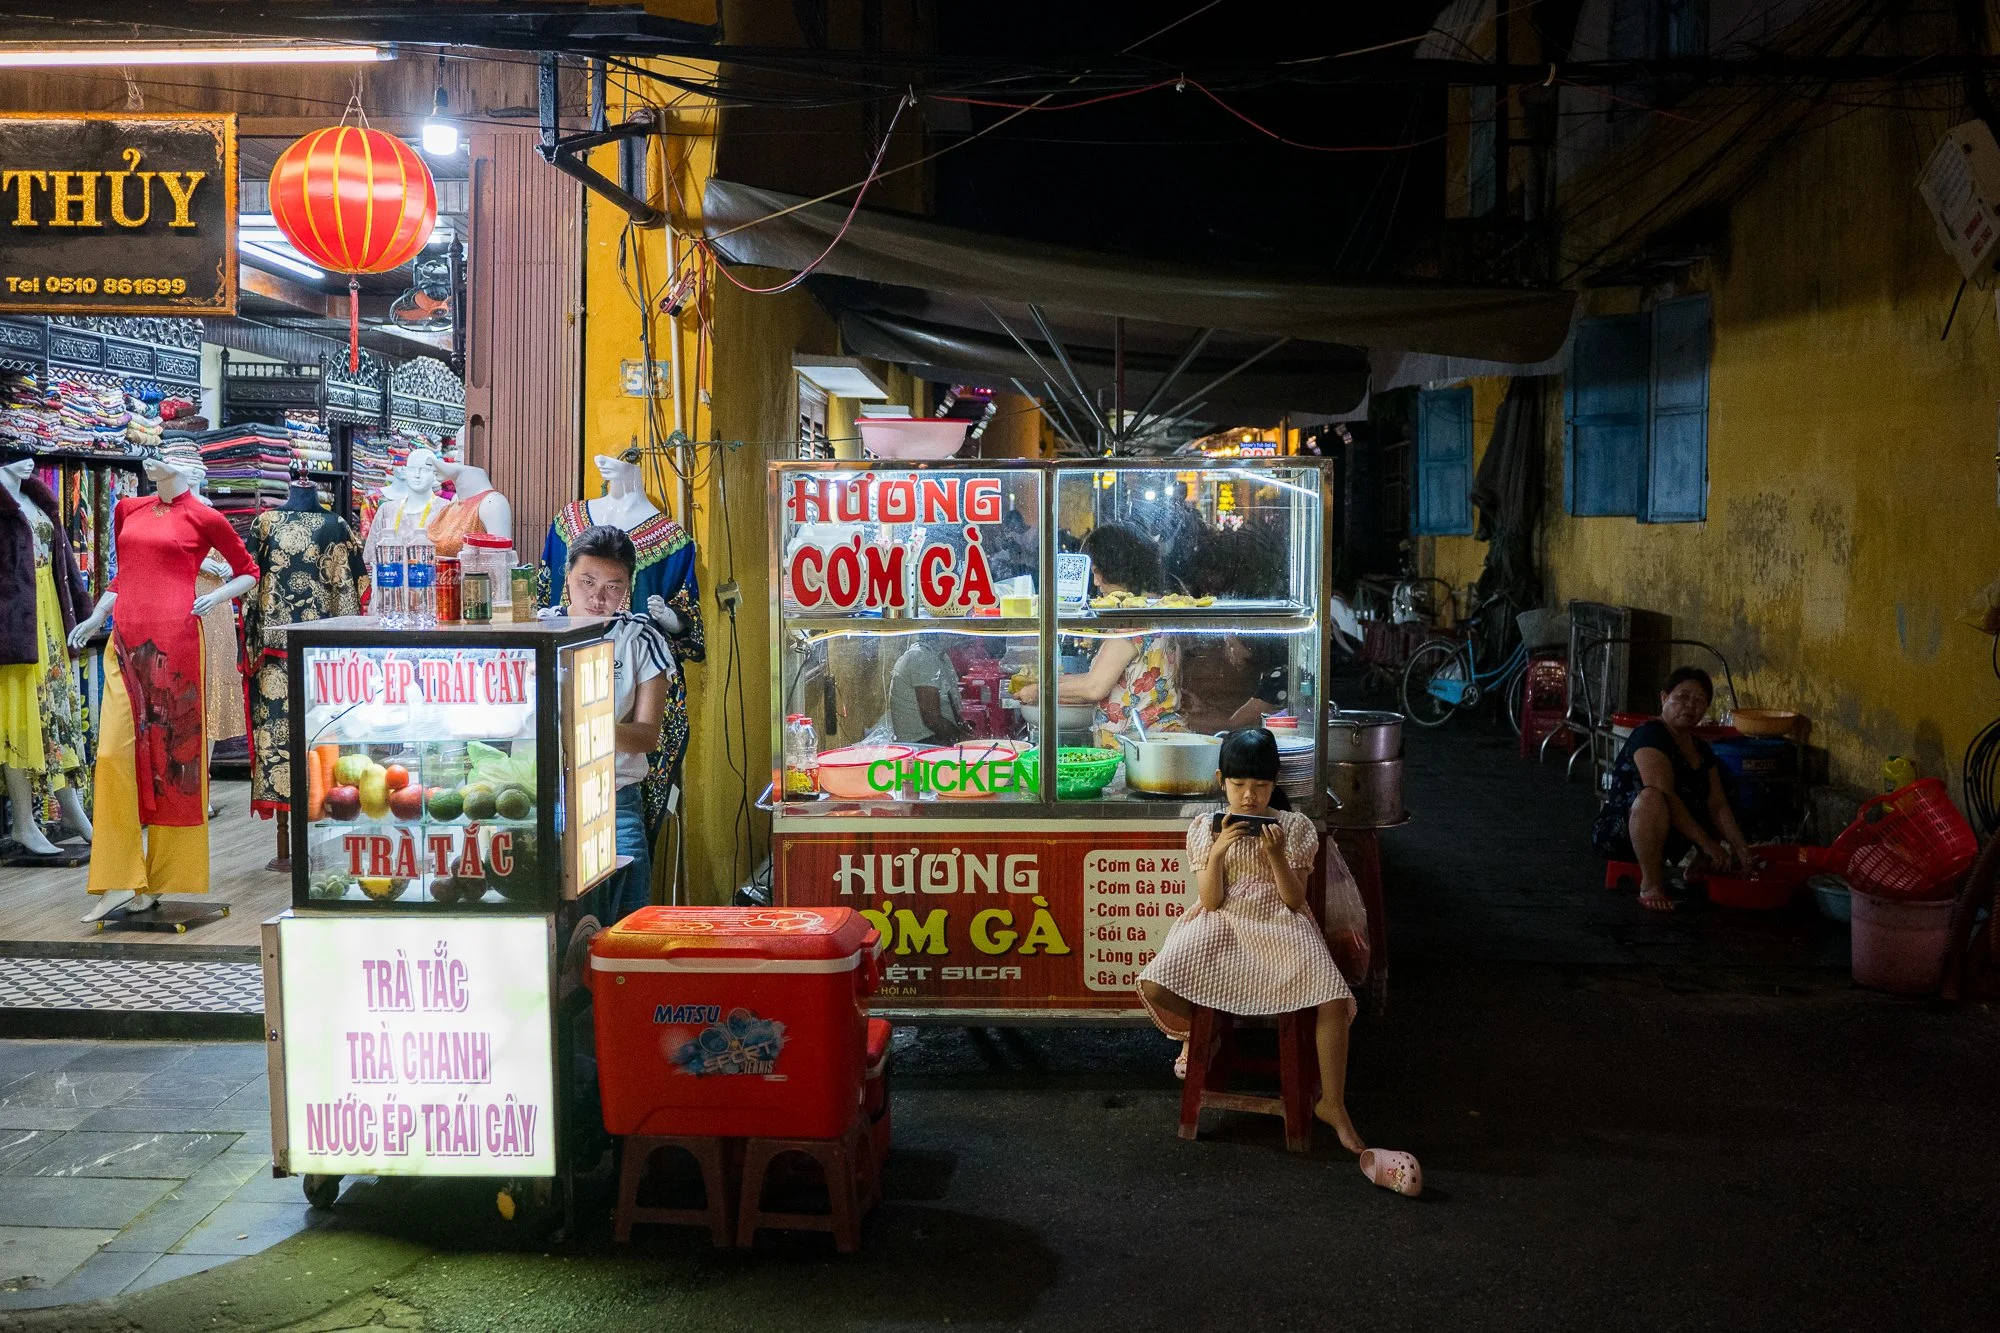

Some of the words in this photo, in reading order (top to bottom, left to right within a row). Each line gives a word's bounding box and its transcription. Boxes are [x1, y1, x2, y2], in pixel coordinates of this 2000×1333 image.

[2, 148, 205, 227] THỦY
[6, 277, 39, 293] Tel
[46, 277, 97, 294] 0510
[103, 278, 187, 294] 861699
[787, 473, 1002, 524] HƯƠNG
[790, 531, 906, 609] CƠM
[919, 525, 998, 608] GÀ
[314, 652, 375, 704] NƯỚC
[384, 652, 412, 704] ÉP
[423, 652, 478, 704] TRÁI
[484, 652, 527, 704] CÂY
[868, 760, 1038, 793] CHICKEN
[343, 821, 421, 879] TRÀ
[428, 820, 514, 879] TẮC
[833, 848, 1039, 895] HƯƠNG
[1097, 858, 1130, 872] Cơm
[1136, 858, 1155, 872] Gà
[1161, 858, 1179, 872] Xé
[1097, 880, 1130, 894] Cơm
[1136, 880, 1155, 894] Gà
[1160, 880, 1185, 894] Đùi
[1097, 903, 1130, 917] Cơm
[1136, 902, 1160, 917] Gỏi
[1165, 903, 1184, 917] Gà
[858, 901, 949, 954] ƠM
[970, 896, 1070, 955] GÀ
[1097, 926, 1121, 941] Gỏi
[1127, 926, 1146, 941] Gà
[1097, 949, 1133, 965] Lòng
[1138, 949, 1157, 965] gà
[362, 949, 413, 1011] TRÀ
[417, 940, 468, 1011] TẮC
[880, 963, 932, 984] ỆT
[1097, 971, 1117, 985] Gà
[1122, 971, 1139, 985] ch
[902, 986, 917, 995] AN
[654, 1005, 720, 1024] MATSU
[346, 1021, 398, 1083] TRÀ
[402, 1031, 491, 1083] CHANH
[744, 1060, 774, 1075] TENNIS
[307, 1092, 377, 1156] NƯỚC
[383, 1093, 416, 1156] ÉP
[421, 1093, 480, 1156] TRÁI
[486, 1093, 537, 1157] CÂY
